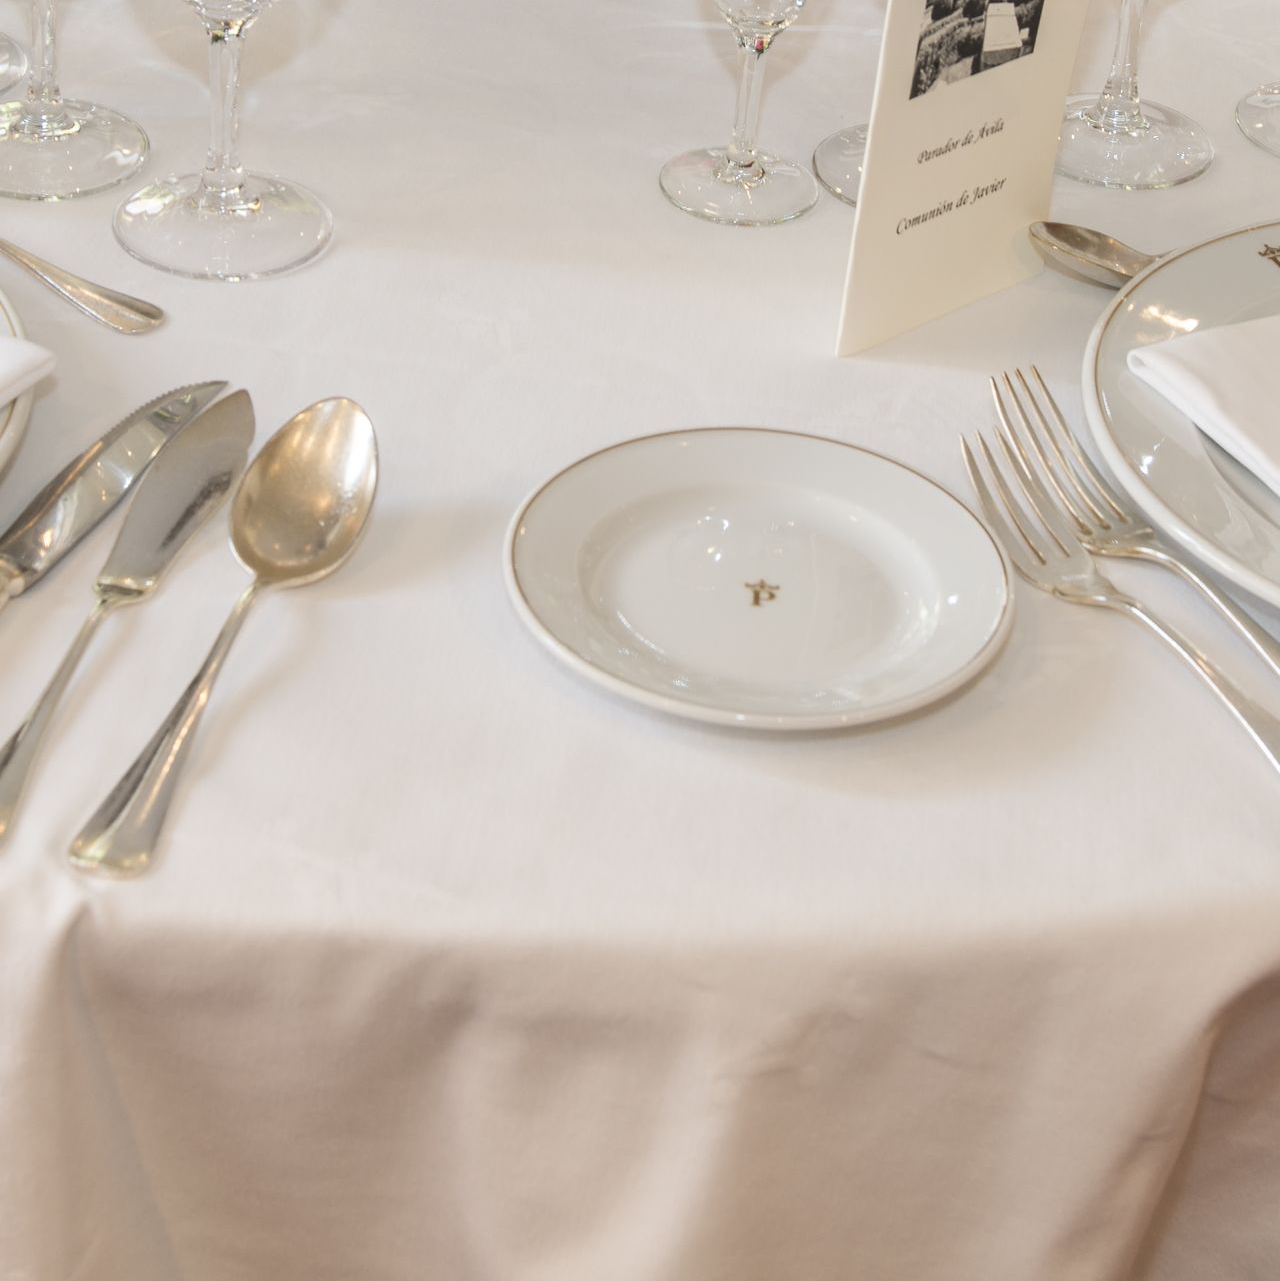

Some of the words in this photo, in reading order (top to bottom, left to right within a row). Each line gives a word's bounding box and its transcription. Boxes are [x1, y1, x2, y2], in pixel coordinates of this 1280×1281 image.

[917, 139, 960, 164] Parador
[961, 132, 974, 147] de
[975, 117, 1005, 143] Ávila
[896, 201, 953, 235] Comunión
[956, 190, 970, 207] de
[971, 176, 1007, 205] Javier
